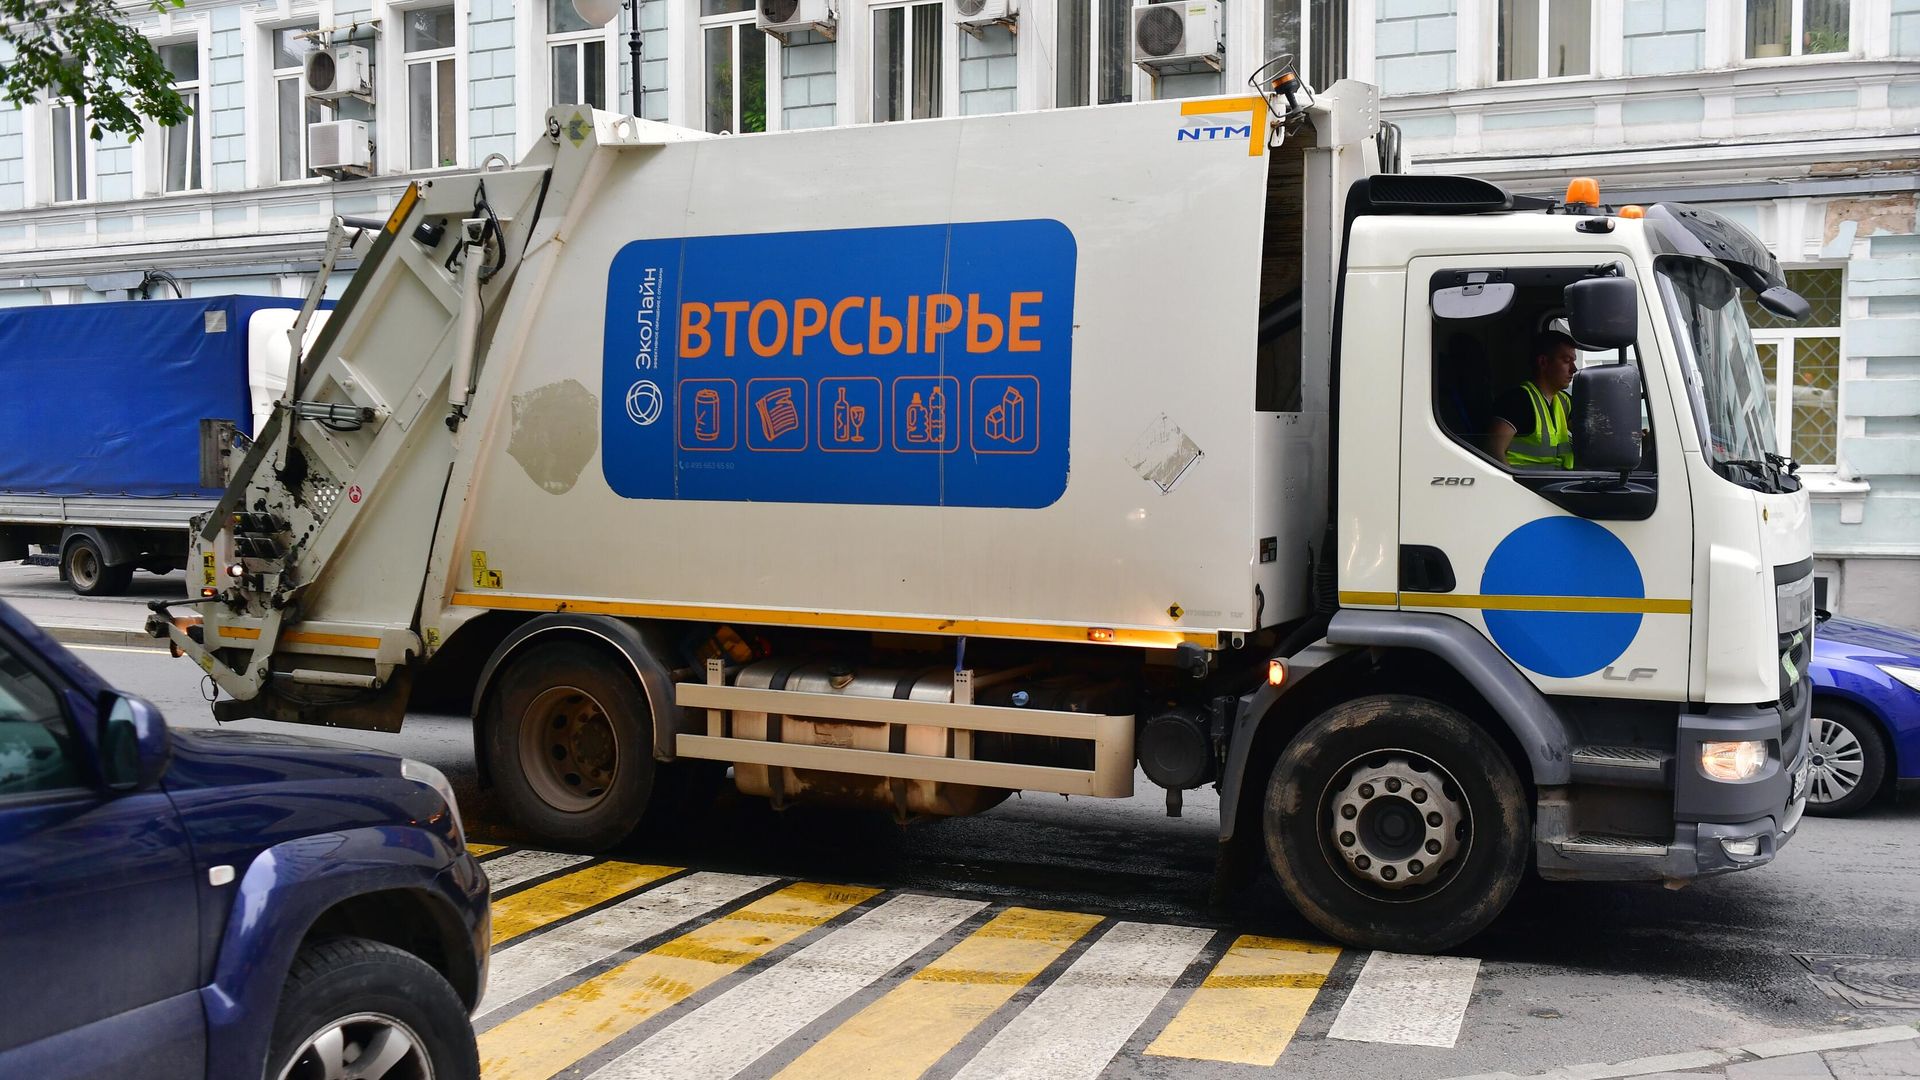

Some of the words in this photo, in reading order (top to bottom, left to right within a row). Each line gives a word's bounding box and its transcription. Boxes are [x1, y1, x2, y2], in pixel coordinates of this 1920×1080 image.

[1177, 125, 1251, 141] NTM
[634, 267, 657, 371] ЭкоЛайн
[679, 291, 1044, 359] ВТОРСЫРЬЕ
[1430, 476, 1476, 486] 280
[1602, 666, 1658, 682] LF
